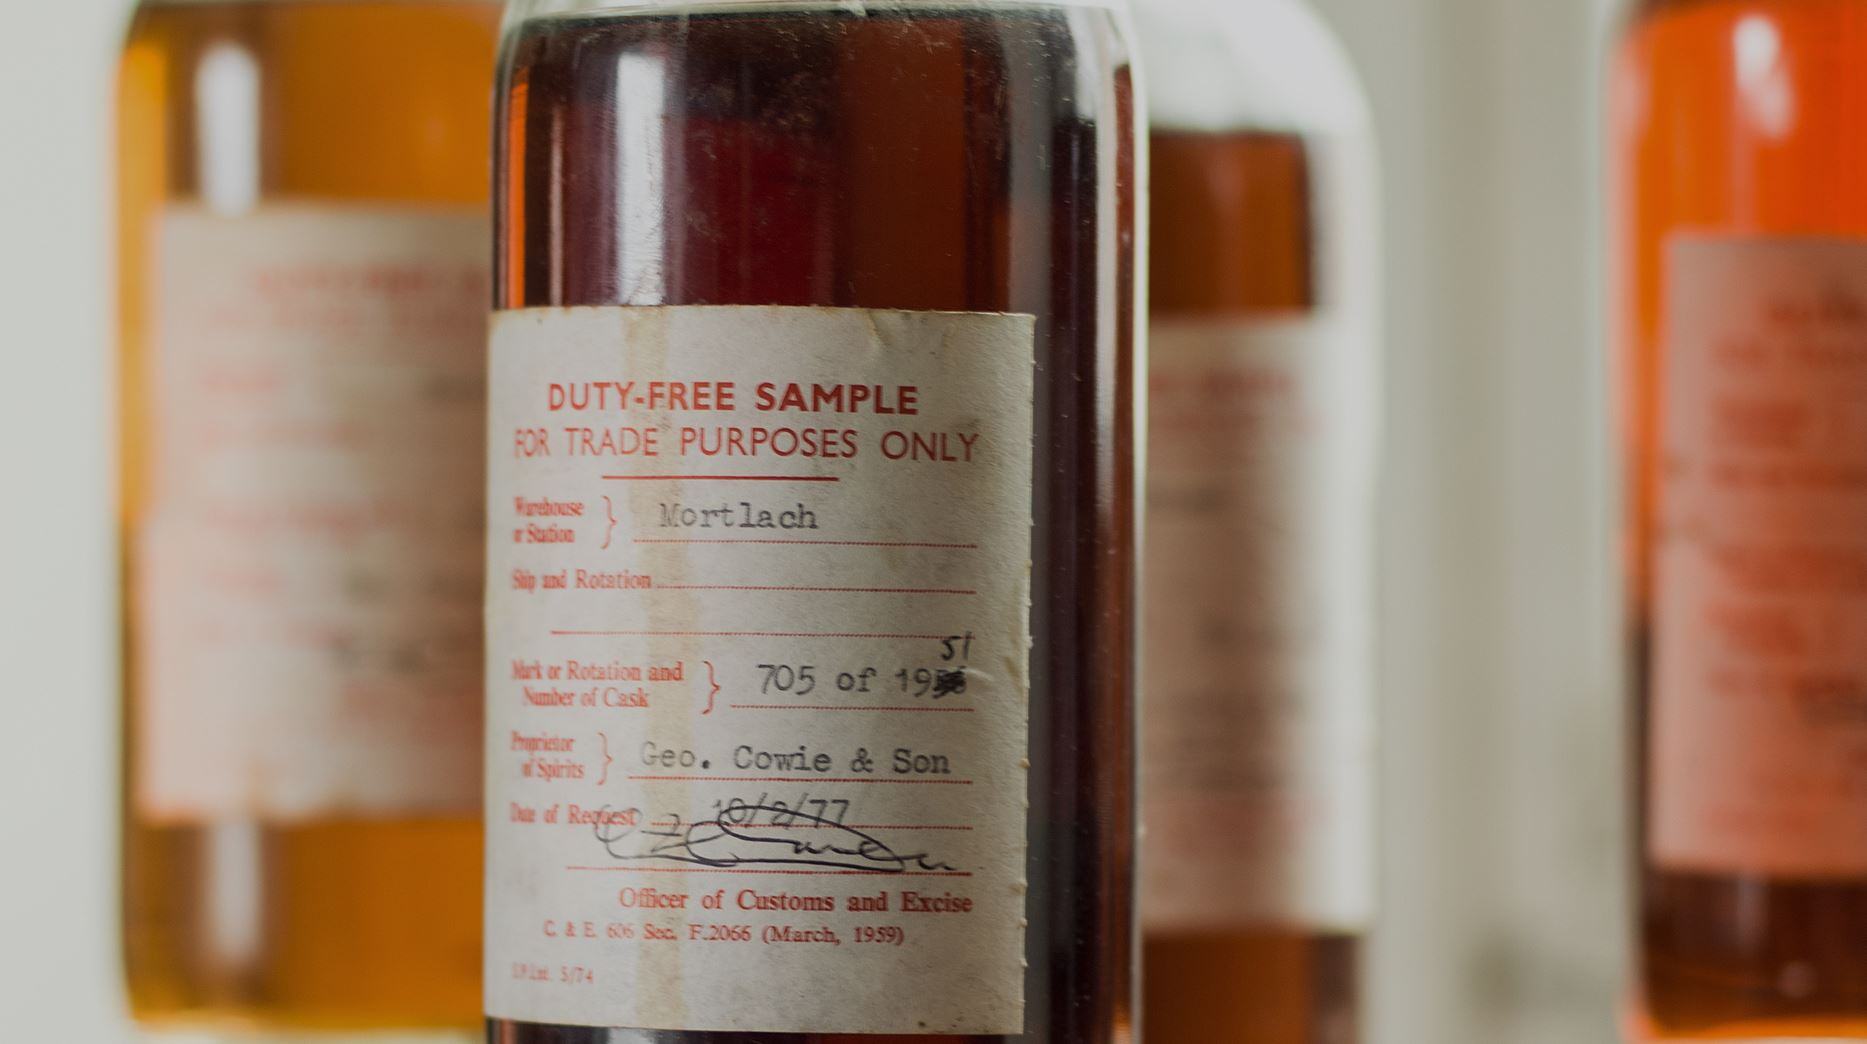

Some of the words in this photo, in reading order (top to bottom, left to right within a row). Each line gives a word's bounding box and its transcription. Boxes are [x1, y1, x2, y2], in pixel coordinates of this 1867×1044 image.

[548, 382, 735, 412] DUTY-FREE
[755, 382, 919, 415] SAMPLE
[513, 428, 550, 458] FOR
[565, 427, 659, 457] TRADE
[680, 427, 858, 459] PURPOSES
[881, 430, 980, 462] ONLY
[514, 496, 585, 517] Warehouse
[659, 501, 820, 530] Mortlach
[526, 523, 576, 543] Station
[511, 568, 537, 594] Ship
[542, 568, 567, 590] and
[575, 567, 653, 590] Rotation
[547, 664, 562, 681] or
[567, 659, 642, 681] Rotation
[648, 660, 685, 682] and
[757, 664, 816, 696] 705
[836, 666, 877, 693] of
[523, 686, 576, 708] Number
[580, 686, 599, 707] of
[603, 686, 651, 708] Cask
[510, 731, 576, 756] Proprietor
[537, 757, 585, 782] Spirits
[641, 741, 711, 770] Geo.
[733, 744, 832, 773] Cowie
[850, 747, 875, 773] &
[893, 748, 951, 775] Son
[510, 802, 536, 823] Date
[543, 803, 560, 824] of
[568, 803, 638, 828] Request
[618, 887, 688, 911] Officer
[699, 888, 724, 911] of
[735, 889, 835, 913] Customs
[847, 890, 888, 913] and
[900, 891, 974, 914] Excise
[687, 923, 752, 943] F.2066
[761, 924, 841, 946] (March,
[854, 925, 905, 946] 1959)
